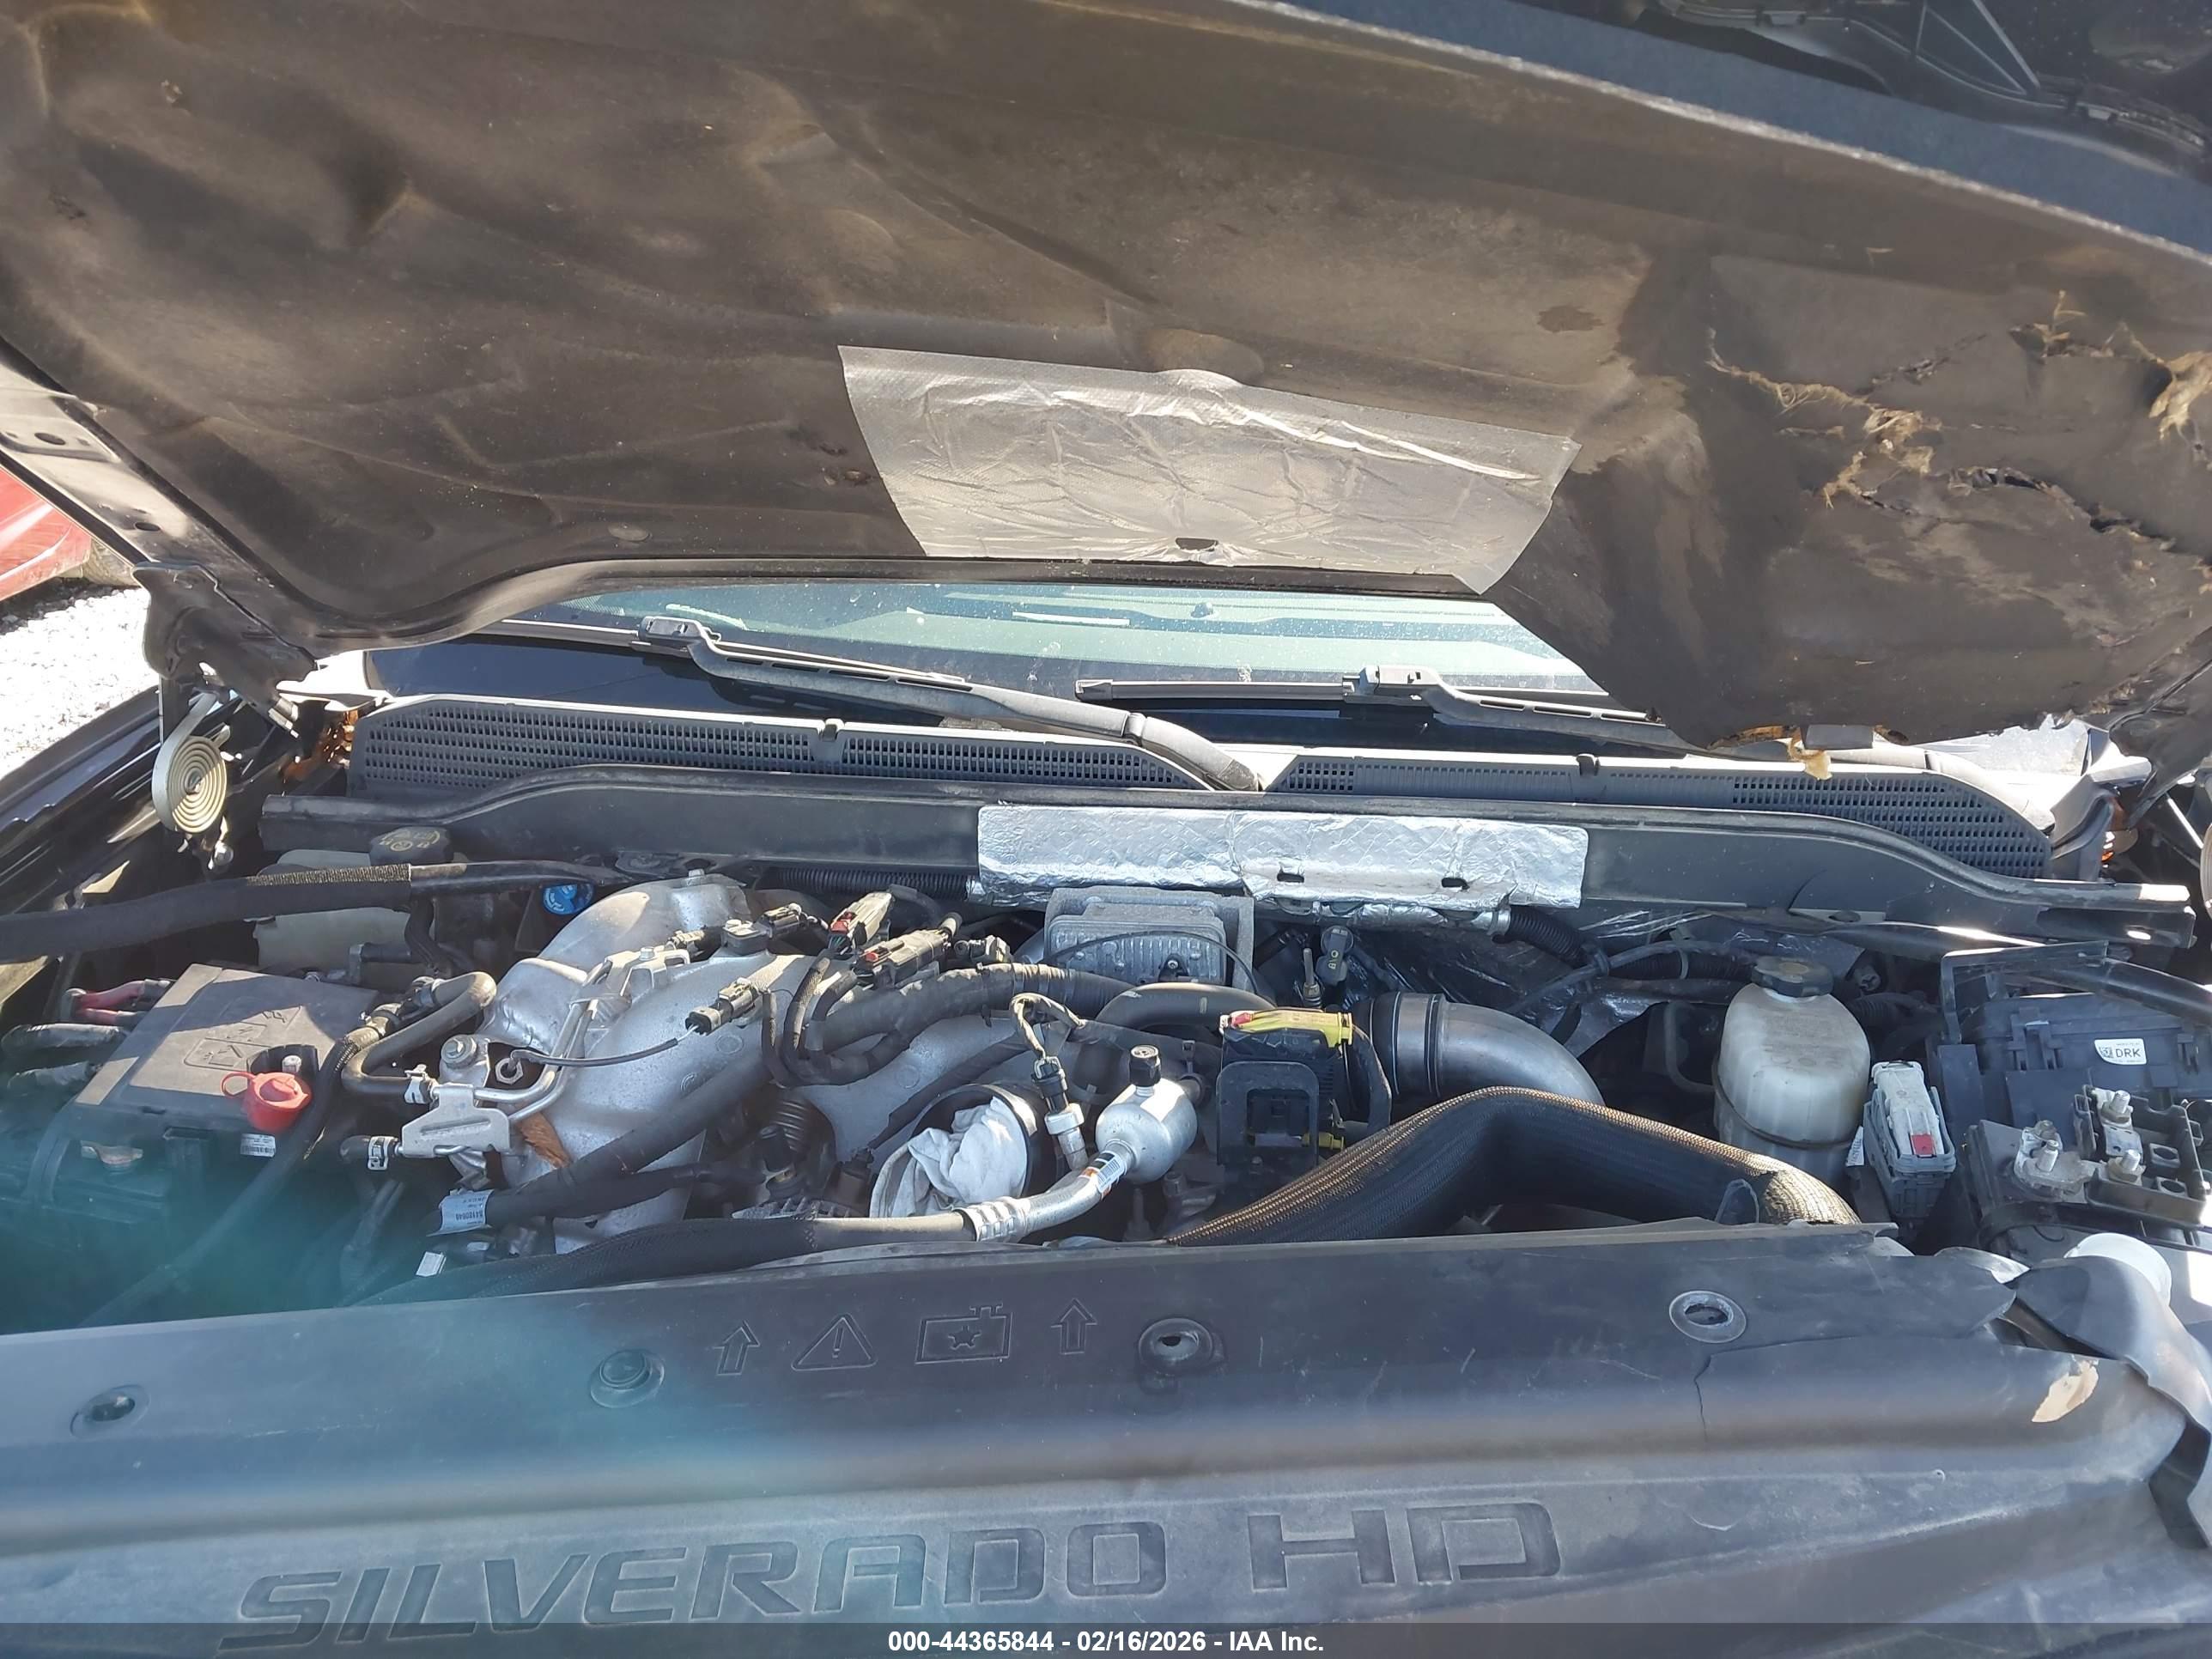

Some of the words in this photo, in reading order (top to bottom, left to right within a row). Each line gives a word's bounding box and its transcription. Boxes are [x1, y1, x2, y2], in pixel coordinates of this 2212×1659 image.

[2115, 1048, 2141, 1058] DRK
[217, 1520, 1166, 1650] SILVERADO
[1247, 1501, 1562, 1591] HD
